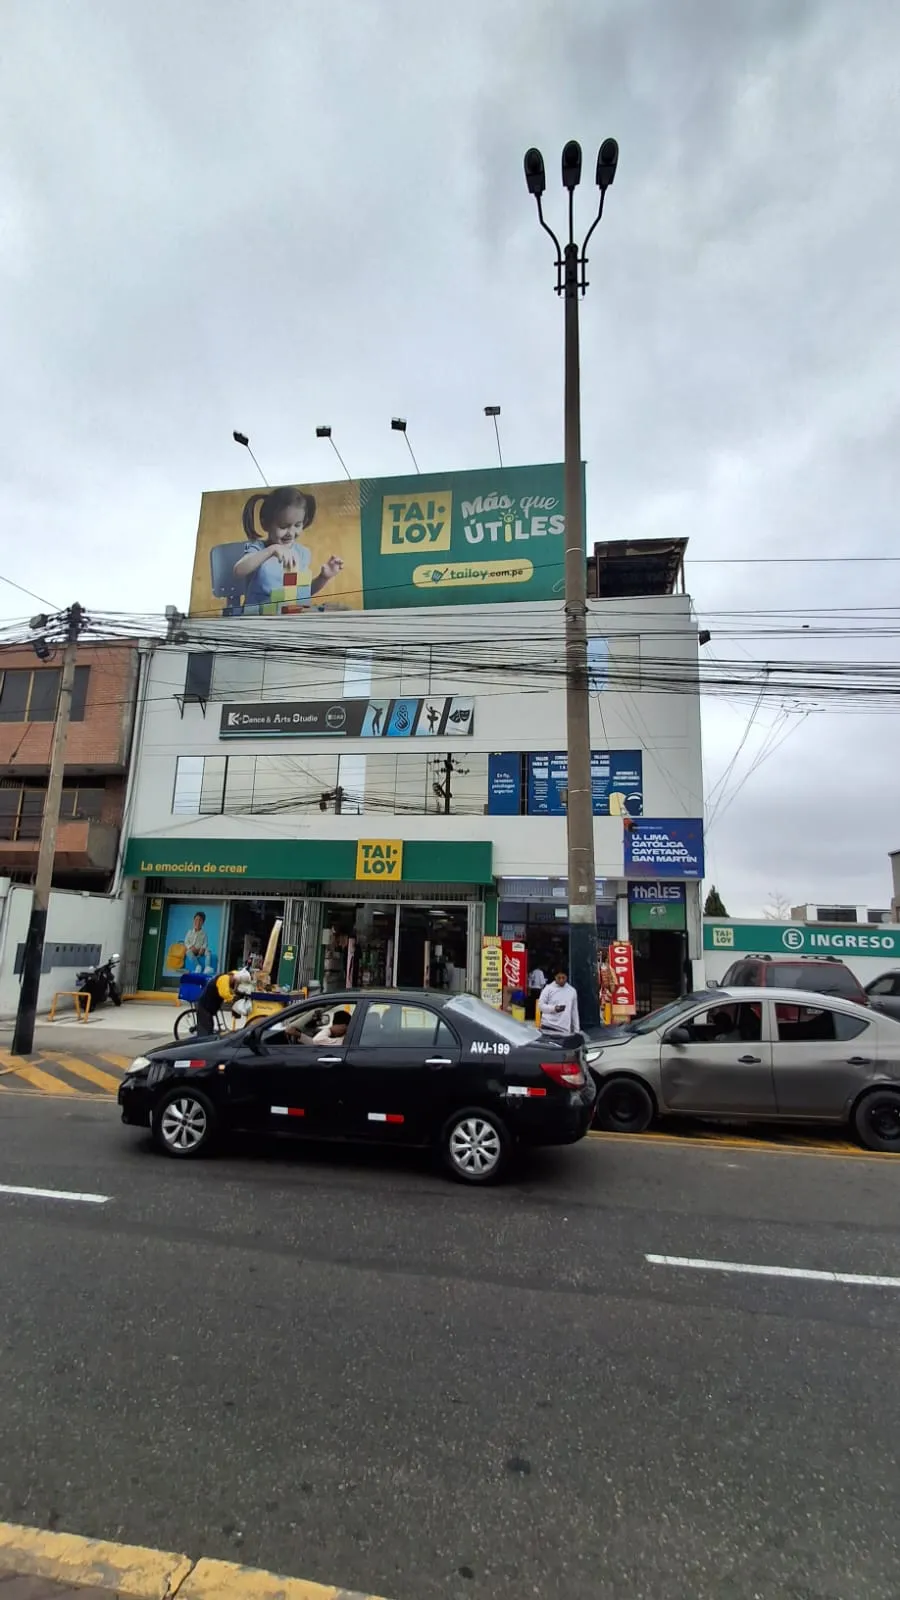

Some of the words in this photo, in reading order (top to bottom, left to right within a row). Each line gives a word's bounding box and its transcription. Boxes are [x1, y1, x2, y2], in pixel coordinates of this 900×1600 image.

[461, 491, 514, 518] Más
[520, 494, 559, 518] que
[391, 521, 444, 544] LOY
[450, 567, 524, 581] tailoy.com.pe
[273, 713, 291, 723] Arts
[292, 713, 318, 723] Studio
[632, 839, 684, 848] CATÓLICA
[656, 854, 697, 863] MARTÍN
[140, 860, 153, 871] La
[155, 861, 201, 872] emoción
[203, 862, 217, 872] de
[219, 864, 248, 873] crear
[363, 860, 397, 874] LOY
[716, 936, 732, 944] LOY
[810, 934, 895, 949] INGRESO
[614, 946, 630, 1004] COPIAS
[470, 1041, 510, 1055] AVJ-199
